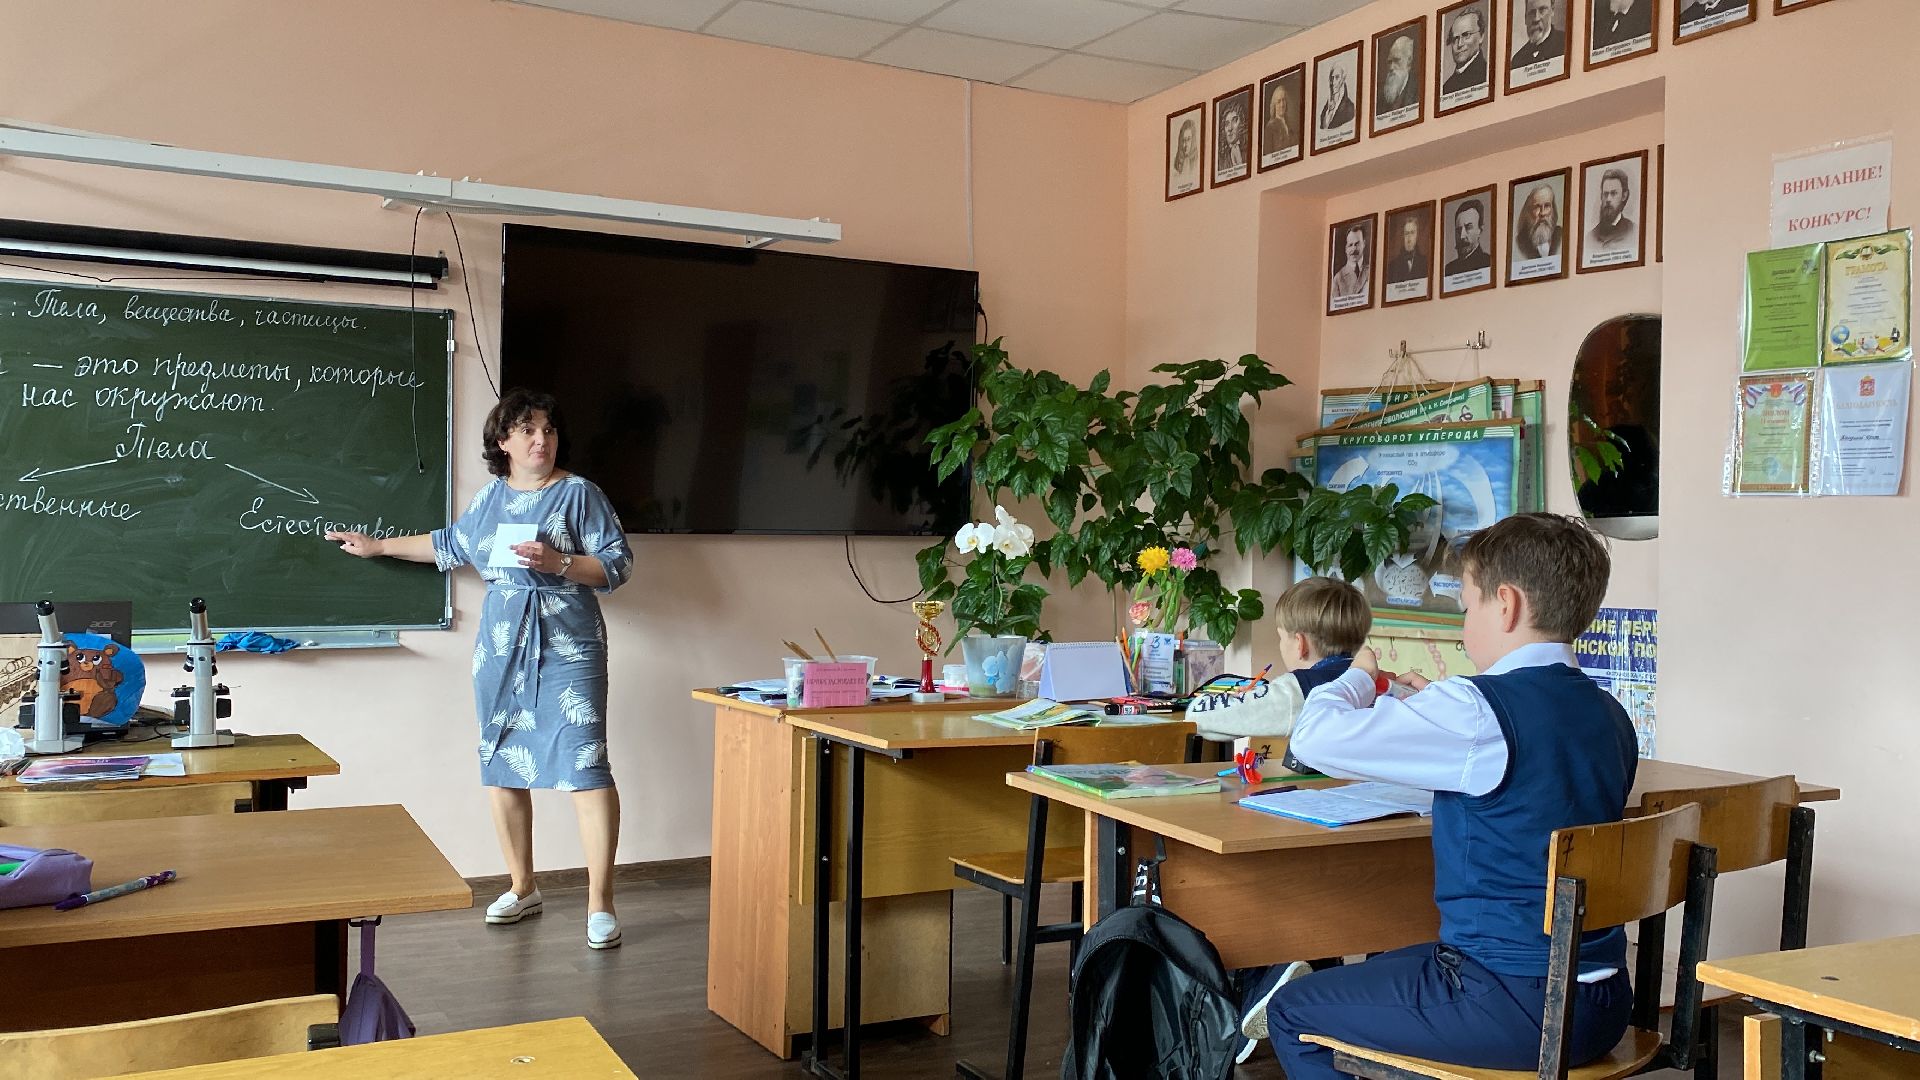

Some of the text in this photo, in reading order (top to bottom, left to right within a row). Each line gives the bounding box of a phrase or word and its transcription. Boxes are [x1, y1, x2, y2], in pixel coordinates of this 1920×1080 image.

[1783, 165, 1883, 196] ВНИМАНИЕ!
[1788, 206, 1871, 233] КОНКУРС!
[1845, 262, 1888, 276] ГРАМОТА
[28, 289, 106, 325] Тела,
[123, 295, 245, 328] вещества,
[254, 309, 367, 333] частицы.
[74, 355, 139, 377] это
[152, 352, 302, 393] предметы,
[308, 361, 425, 399] которые
[95, 384, 275, 422] окружают.
[116, 421, 216, 460] Тела
[1342, 430, 1480, 445] КРУГОВОРОТ УГЛЕРОДА
[0, 485, 141, 522] твенные
[90, 620, 118, 628] acer
[1561, 833, 1575, 868] 7
